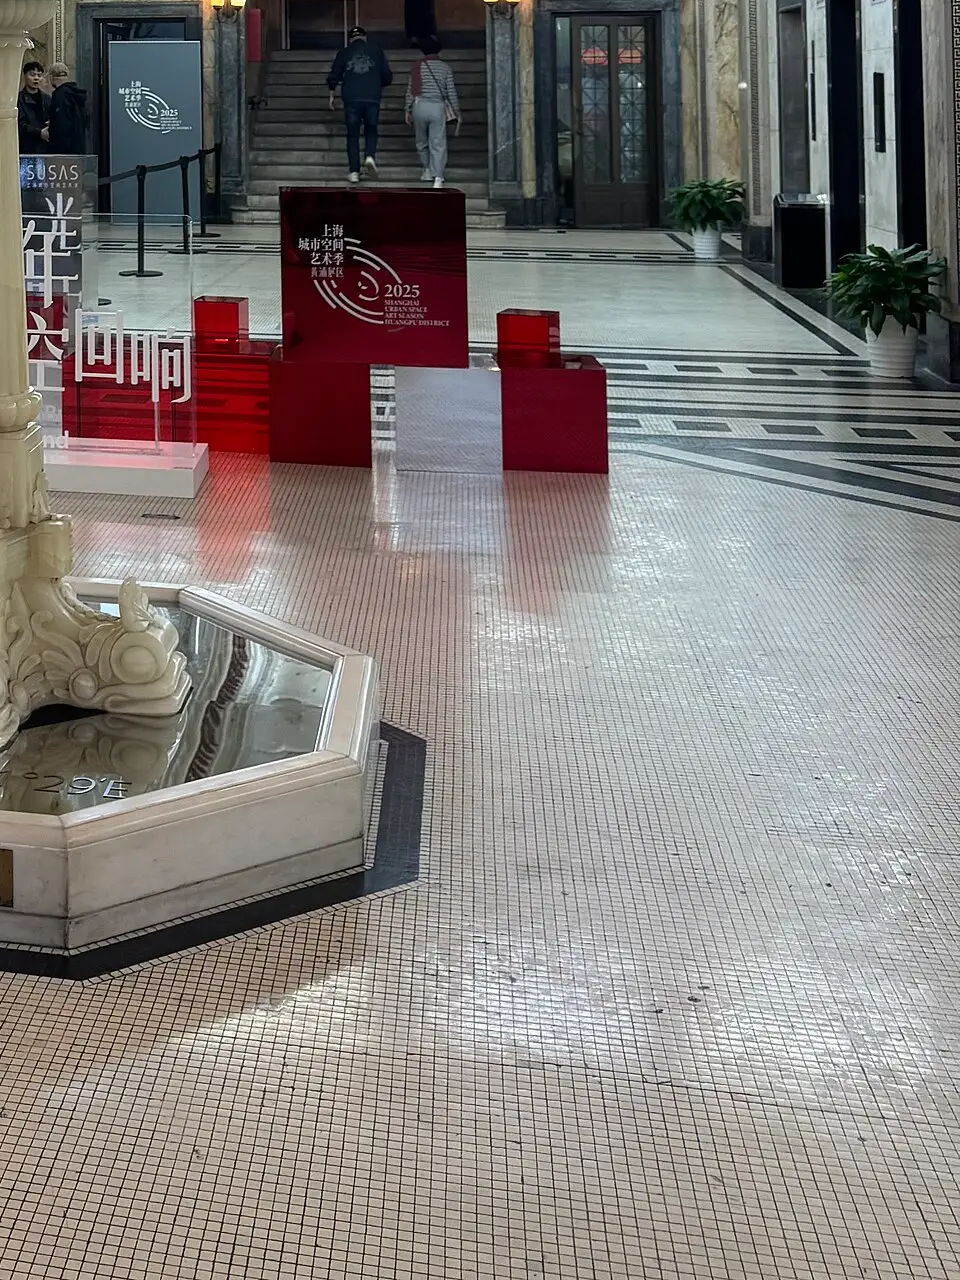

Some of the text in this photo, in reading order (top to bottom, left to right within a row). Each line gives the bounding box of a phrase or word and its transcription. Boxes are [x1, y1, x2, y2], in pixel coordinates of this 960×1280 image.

[160, 109, 178, 117] 2025
[26, 164, 79, 180] SUSAS
[321, 224, 344, 237] 上海
[298, 238, 344, 251] 城市空间
[310, 253, 344, 265] 艺术季
[384, 284, 420, 298] 2025
